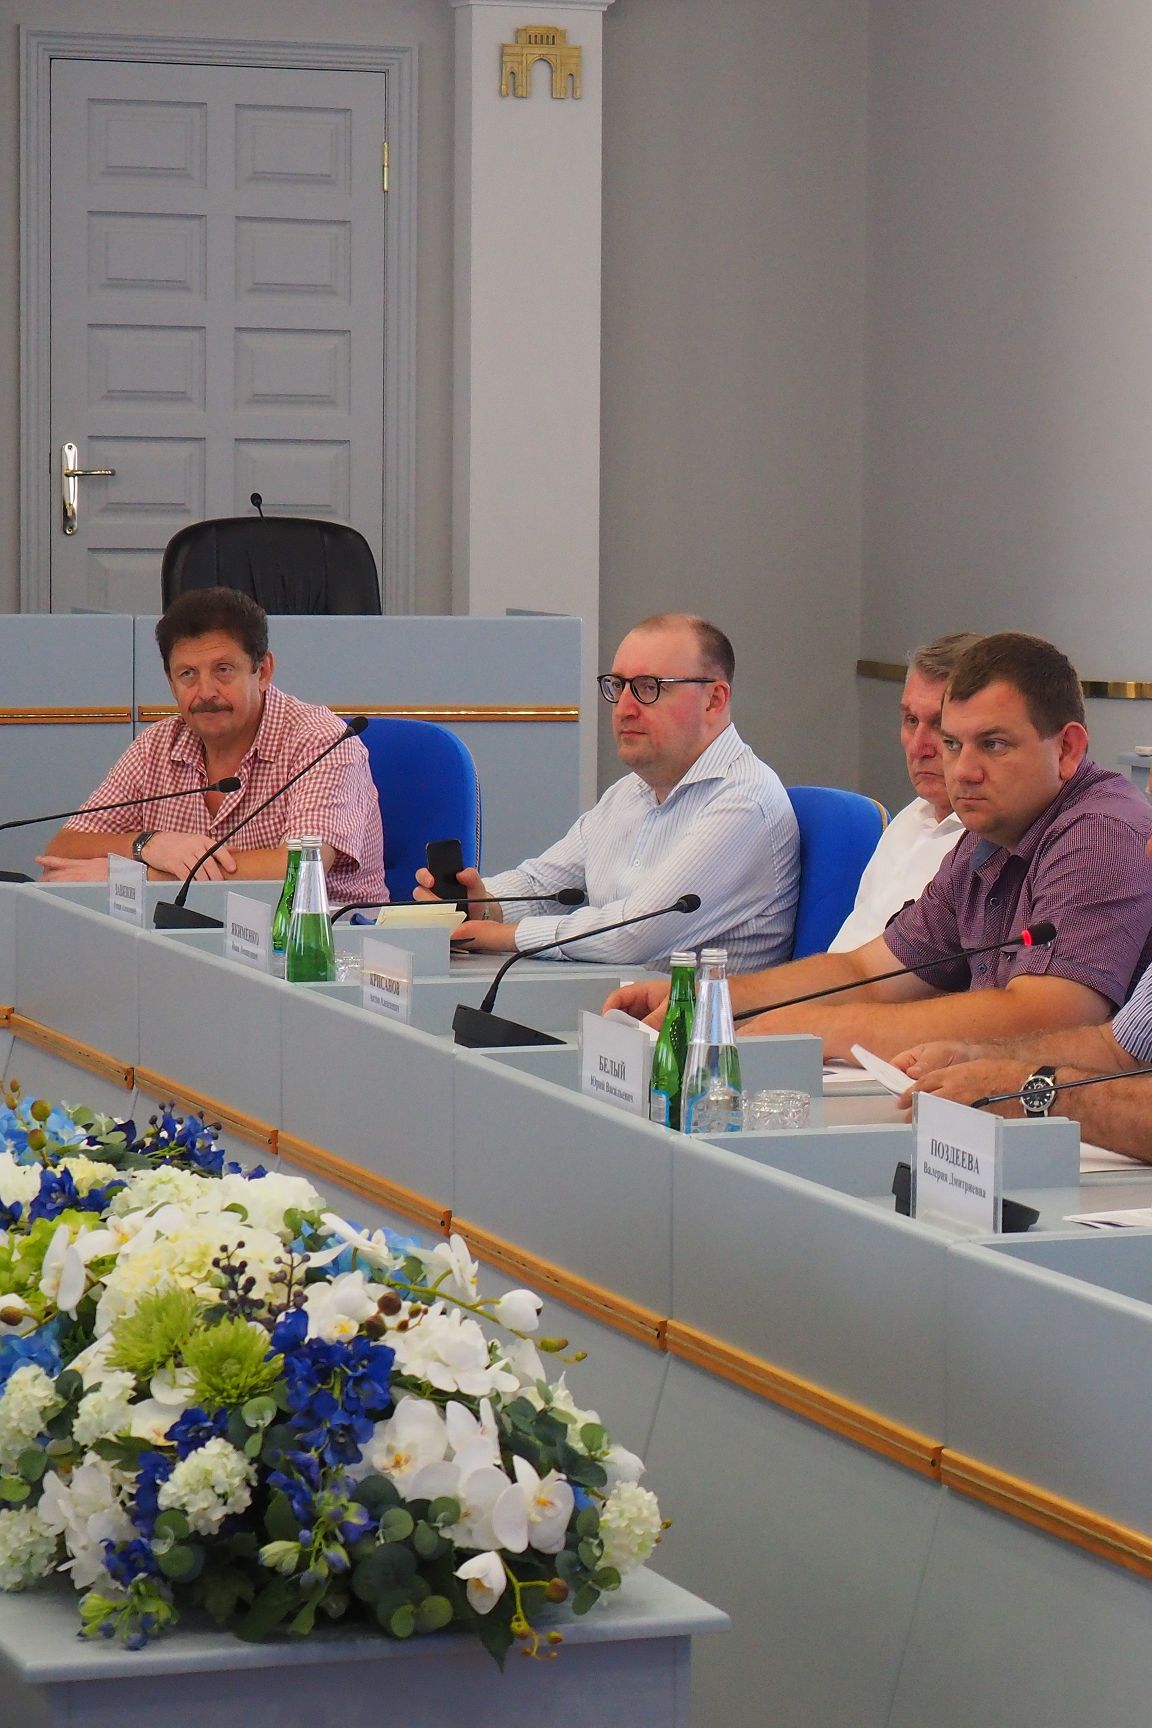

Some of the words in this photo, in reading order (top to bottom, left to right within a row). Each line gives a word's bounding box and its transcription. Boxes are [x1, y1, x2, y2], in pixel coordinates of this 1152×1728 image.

[599, 1055, 626, 1081] БЕЛЫЙ
[930, 1138, 980, 1175] ПОЗДЕЕВА
[923, 1160, 948, 1182] Валерия
[948, 1172, 987, 1198] Дмитриевна
